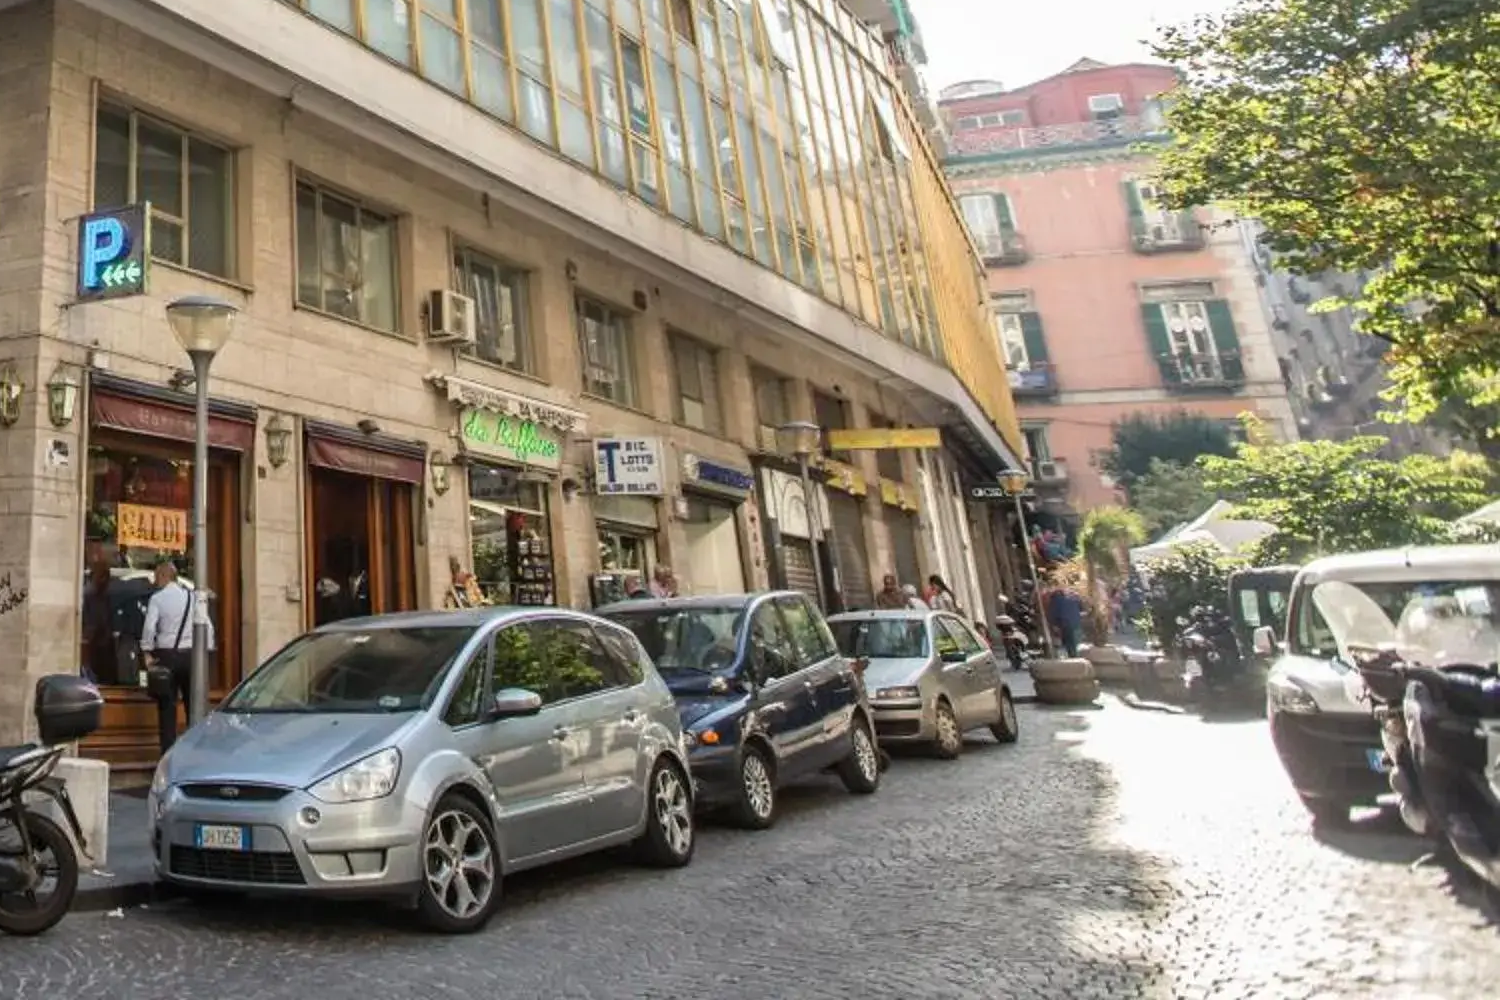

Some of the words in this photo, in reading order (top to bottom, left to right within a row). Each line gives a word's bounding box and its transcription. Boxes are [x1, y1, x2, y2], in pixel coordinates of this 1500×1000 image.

[84, 217, 123, 287] P
[597, 442, 621, 482] T
[620, 455, 653, 465] LOTTO
[122, 511, 182, 544] SALDI
